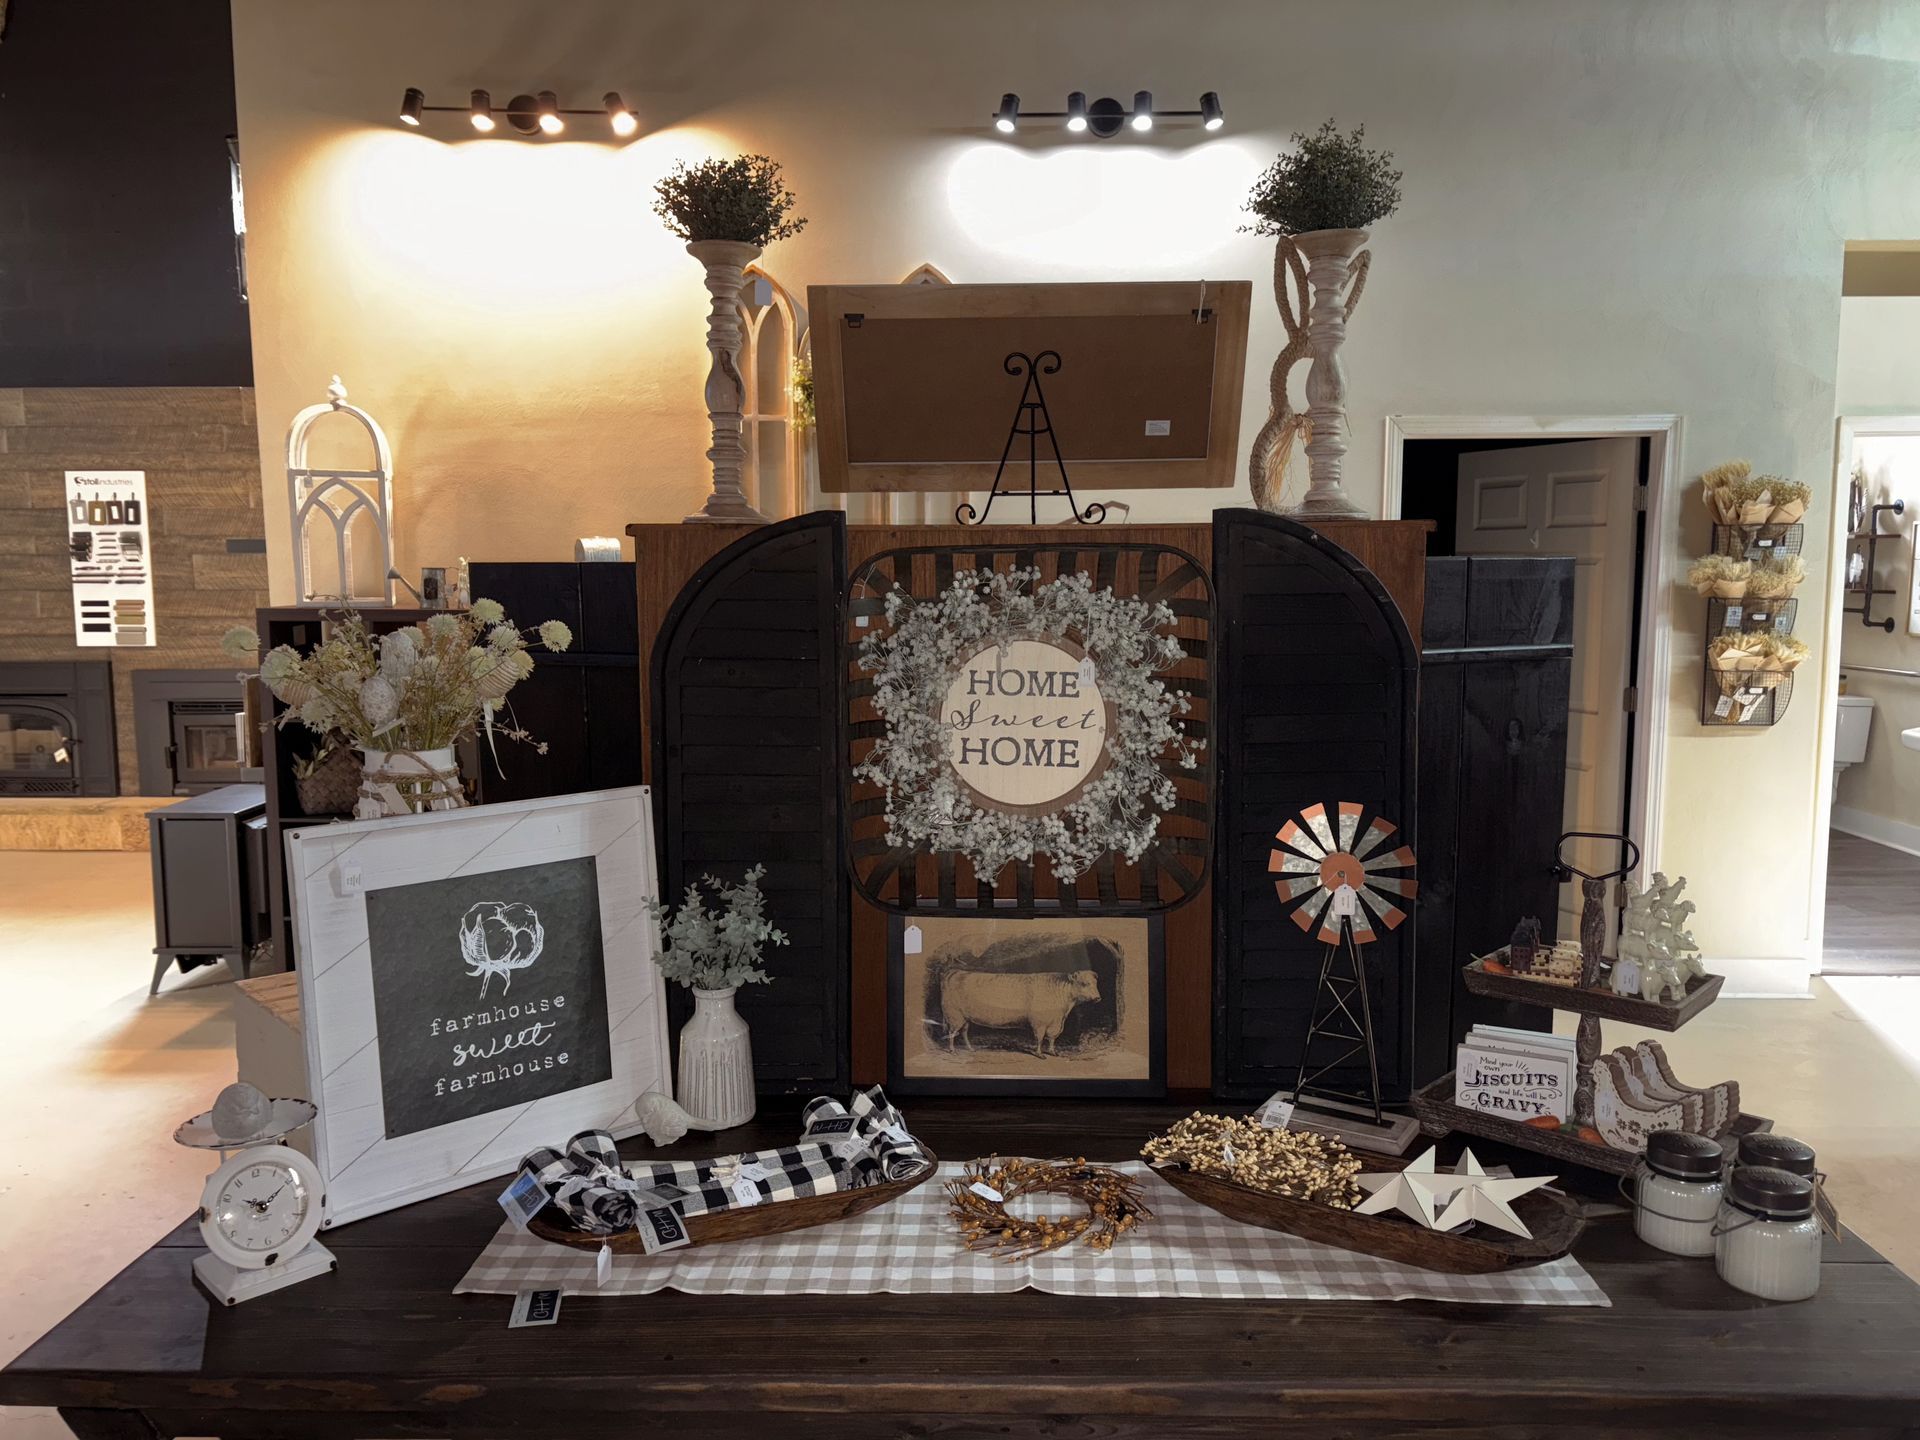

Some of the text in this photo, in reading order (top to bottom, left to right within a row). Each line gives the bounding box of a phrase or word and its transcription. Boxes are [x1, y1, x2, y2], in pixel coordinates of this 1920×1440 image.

[967, 668, 1081, 698] HOME
[949, 698, 1097, 731] Sweet
[958, 736, 1080, 768] HOME
[430, 995, 566, 1037] farmhouse
[452, 1021, 557, 1067] sweet
[434, 1052, 570, 1097] farmhouse
[1479, 1056, 1514, 1068] Mind your
[1477, 1091, 1547, 1115] GRAVY
[1512, 1089, 1523, 1097] life
[1525, 1091, 1538, 1099] will
